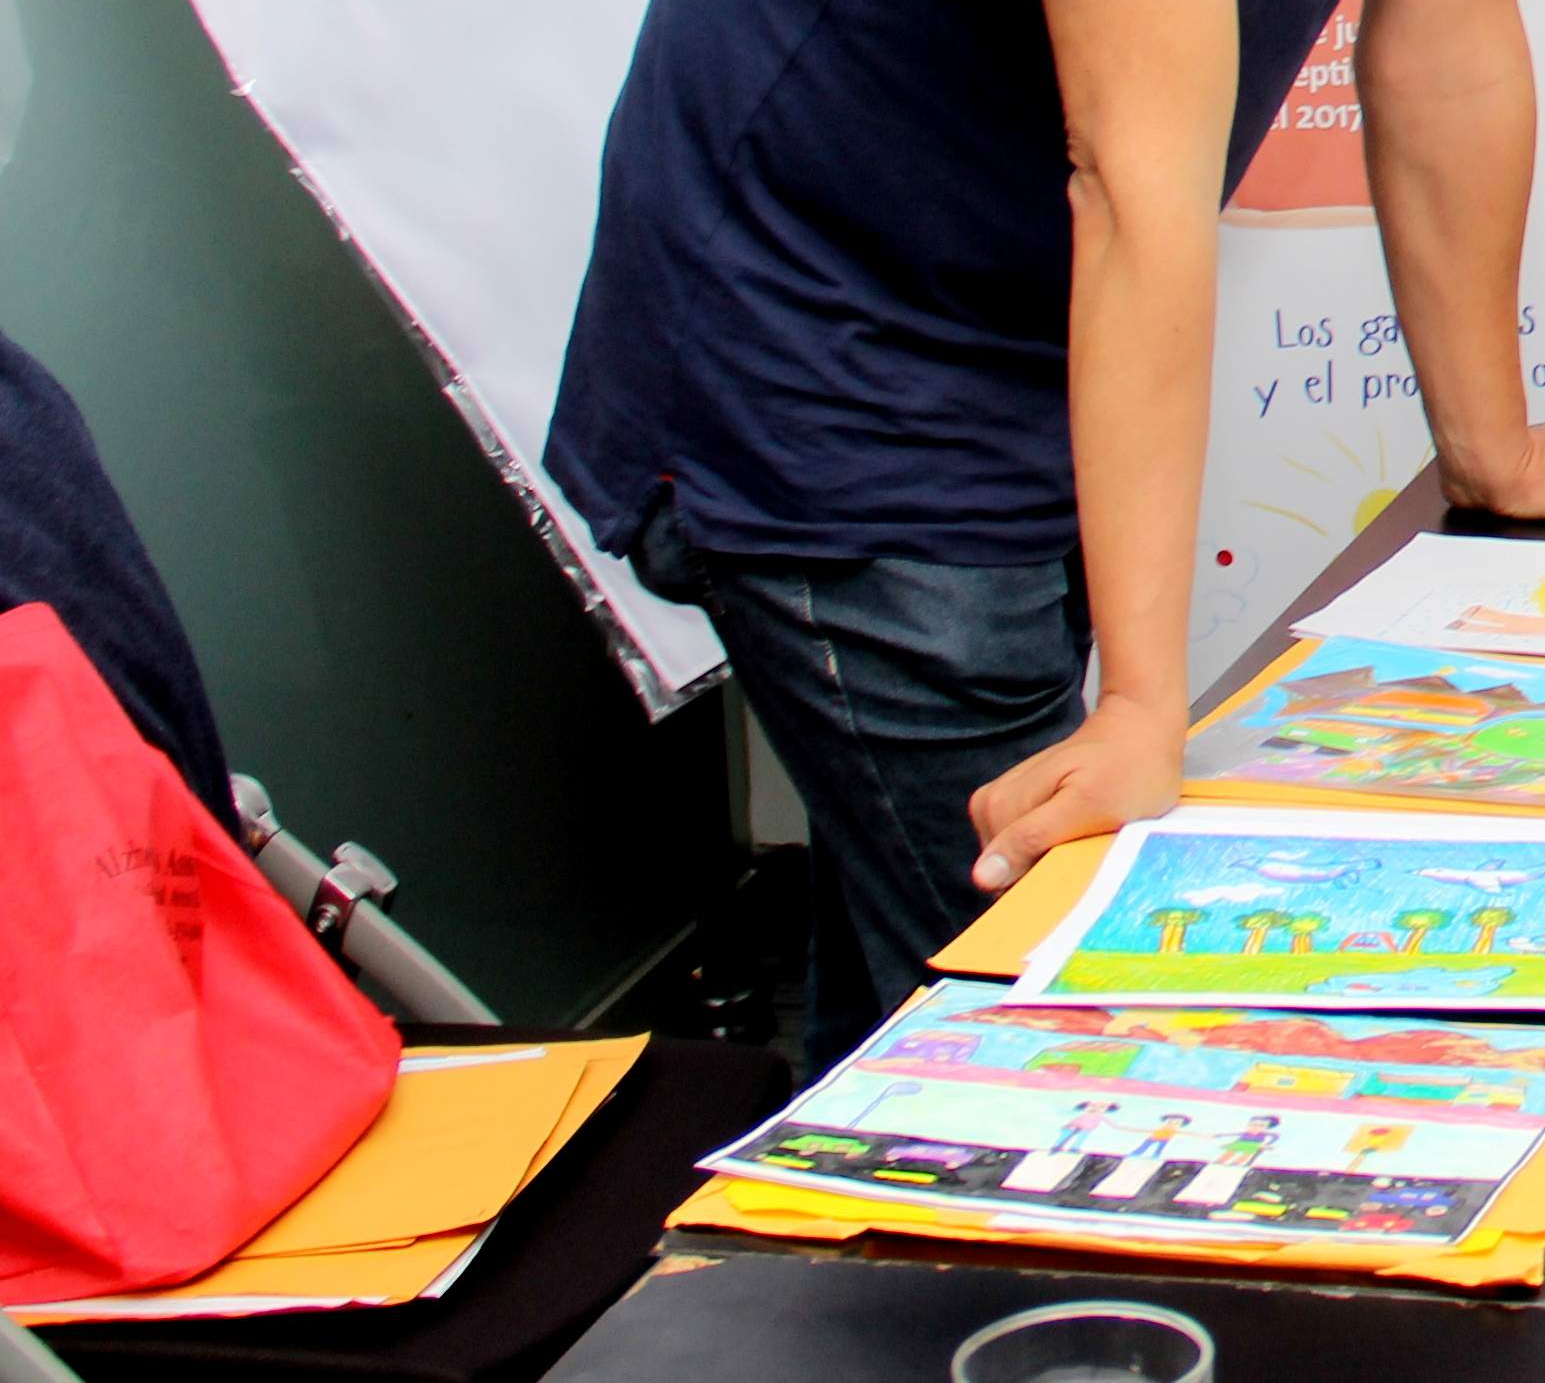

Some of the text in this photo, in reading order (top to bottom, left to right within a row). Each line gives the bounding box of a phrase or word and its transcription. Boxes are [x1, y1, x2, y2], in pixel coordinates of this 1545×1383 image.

[1295, 103, 1362, 132] 2017
[1276, 310, 1333, 348] Los
[1255, 380, 1278, 417] y
[1305, 360, 1332, 403] el
